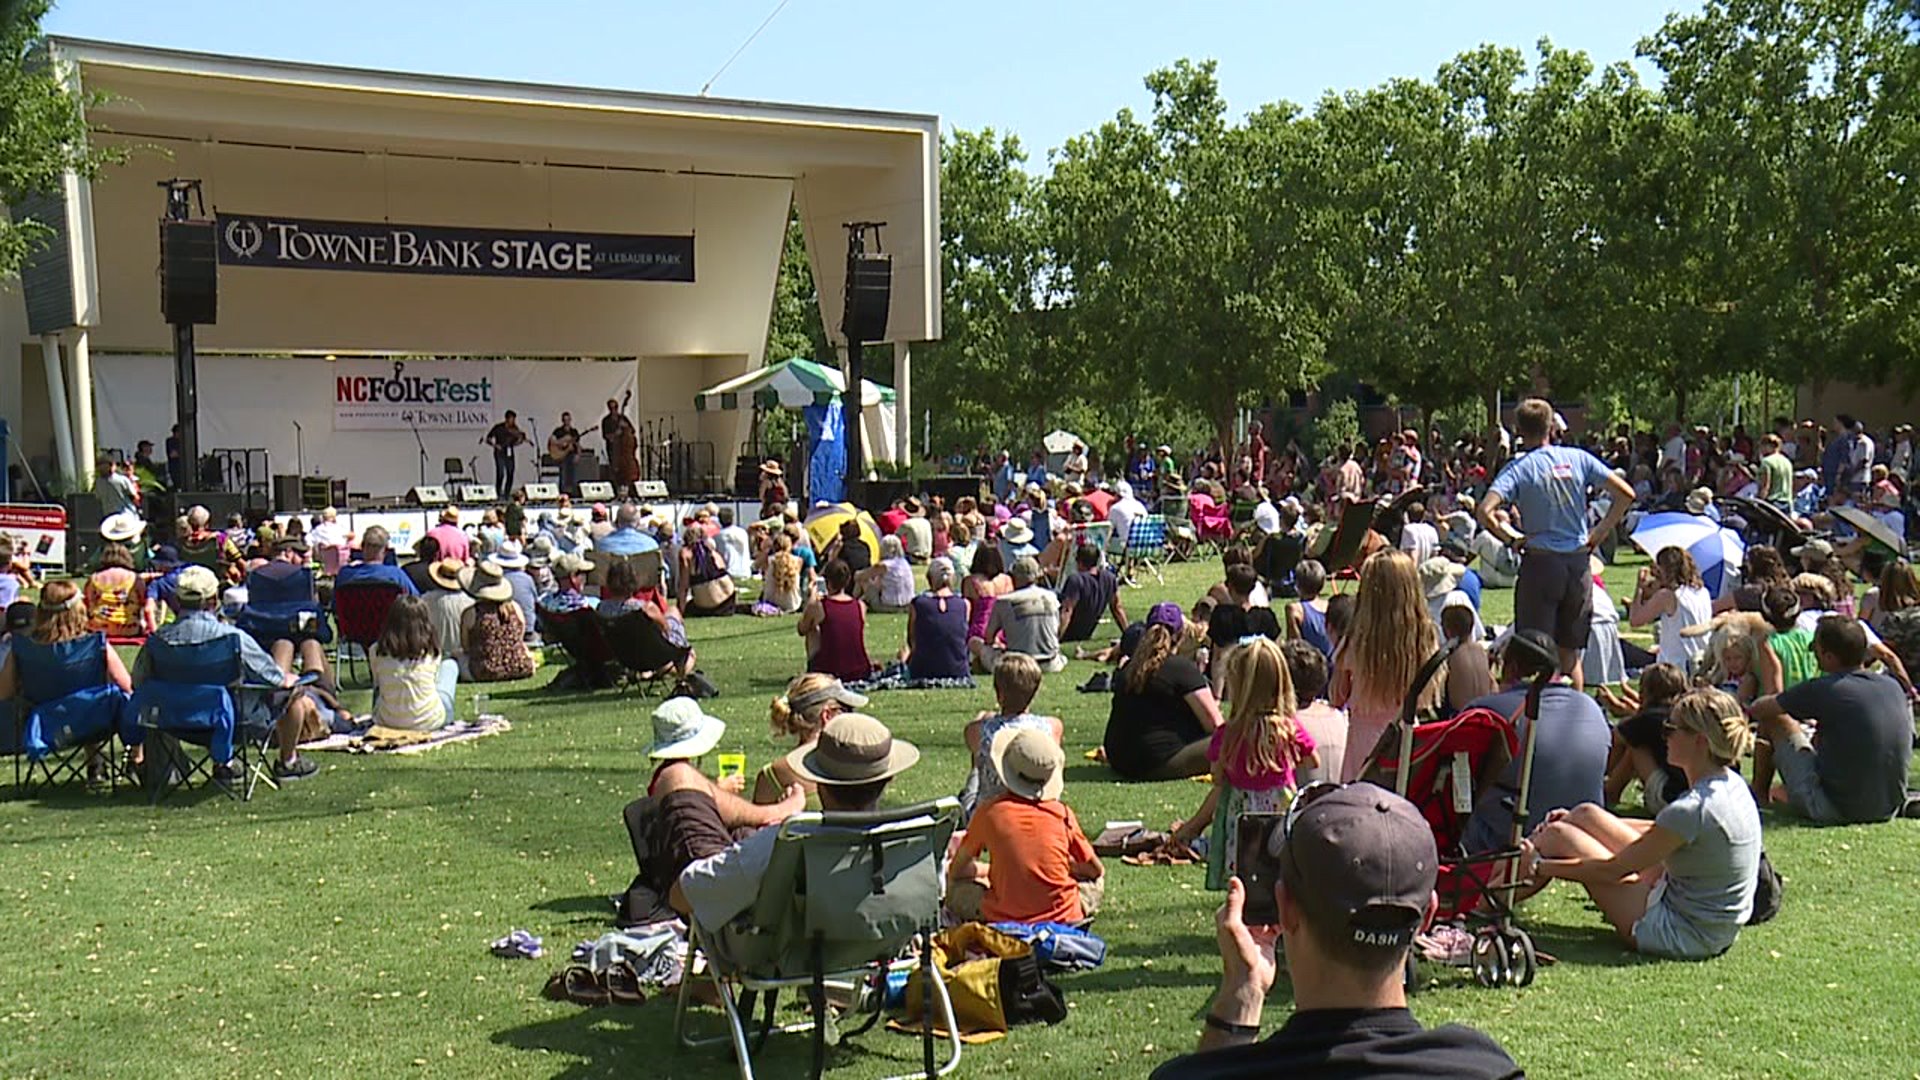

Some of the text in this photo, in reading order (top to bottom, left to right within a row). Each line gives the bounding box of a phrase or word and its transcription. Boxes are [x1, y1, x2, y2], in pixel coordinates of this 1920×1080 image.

[491, 239, 592, 272] STAGE
[594, 252, 606, 263] AT
[608, 252, 653, 264] LEBAUER
[655, 253, 681, 265] PARK
[1354, 929, 1399, 946] DASH
